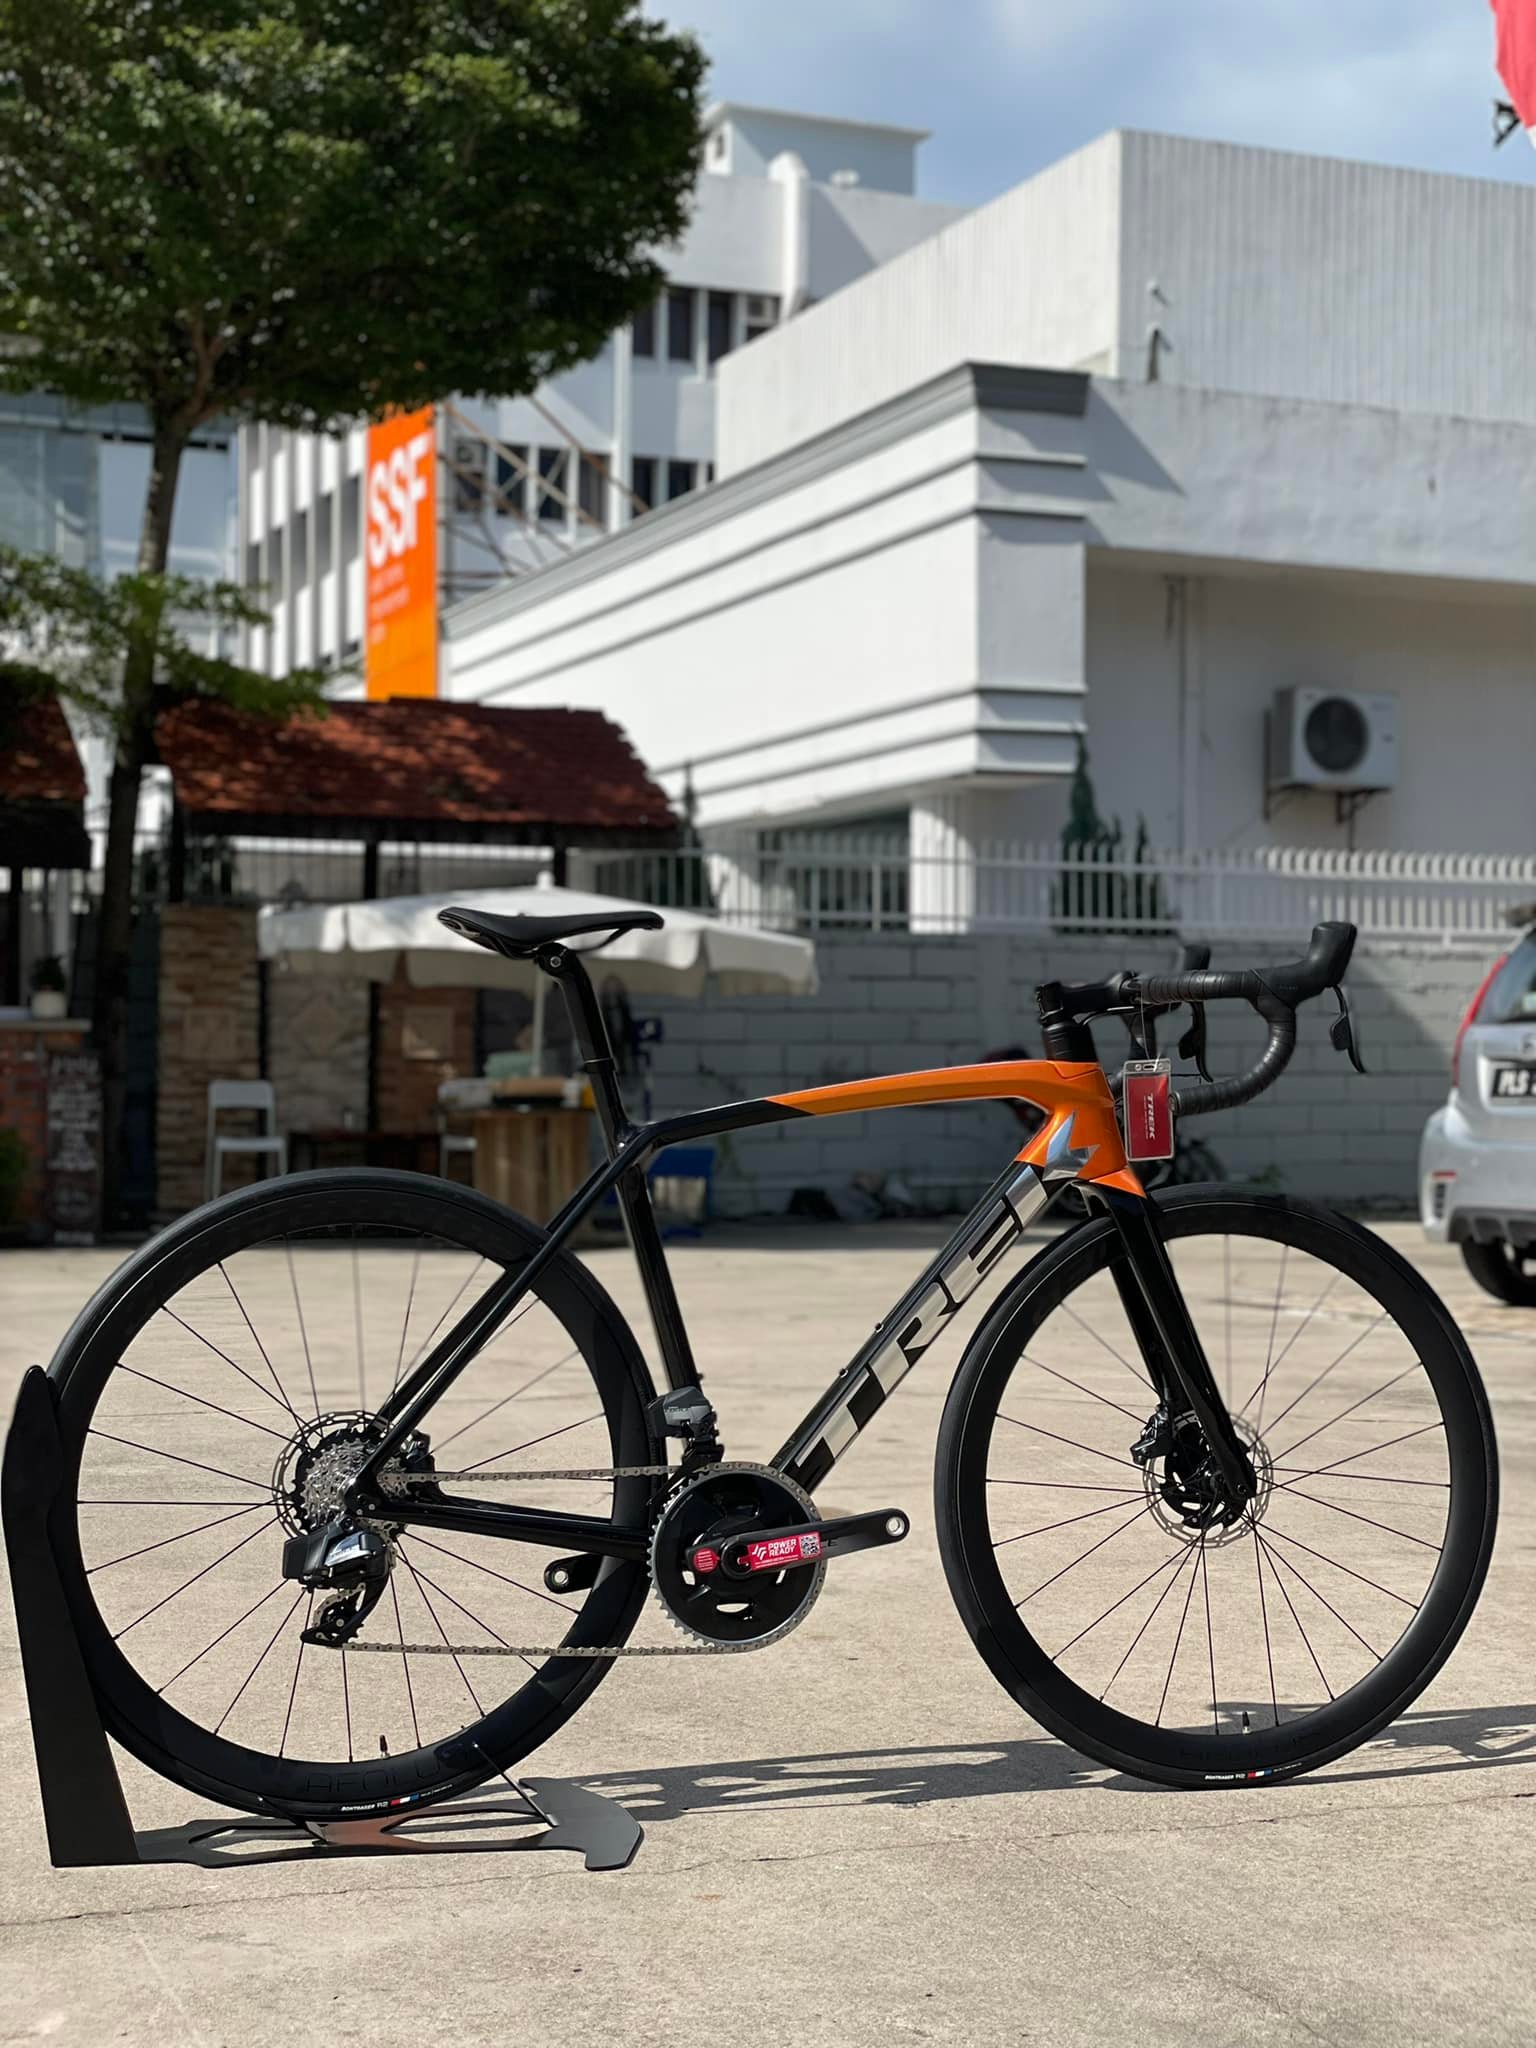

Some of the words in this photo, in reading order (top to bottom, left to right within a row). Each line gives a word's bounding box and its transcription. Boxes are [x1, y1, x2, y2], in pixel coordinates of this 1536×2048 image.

[369, 433, 433, 567] SSF
[1147, 1093, 1155, 1140] TREK
[795, 1109, 1100, 1468] TREK
[768, 1539, 797, 1550] POWER
[769, 1546, 795, 1557] READY
